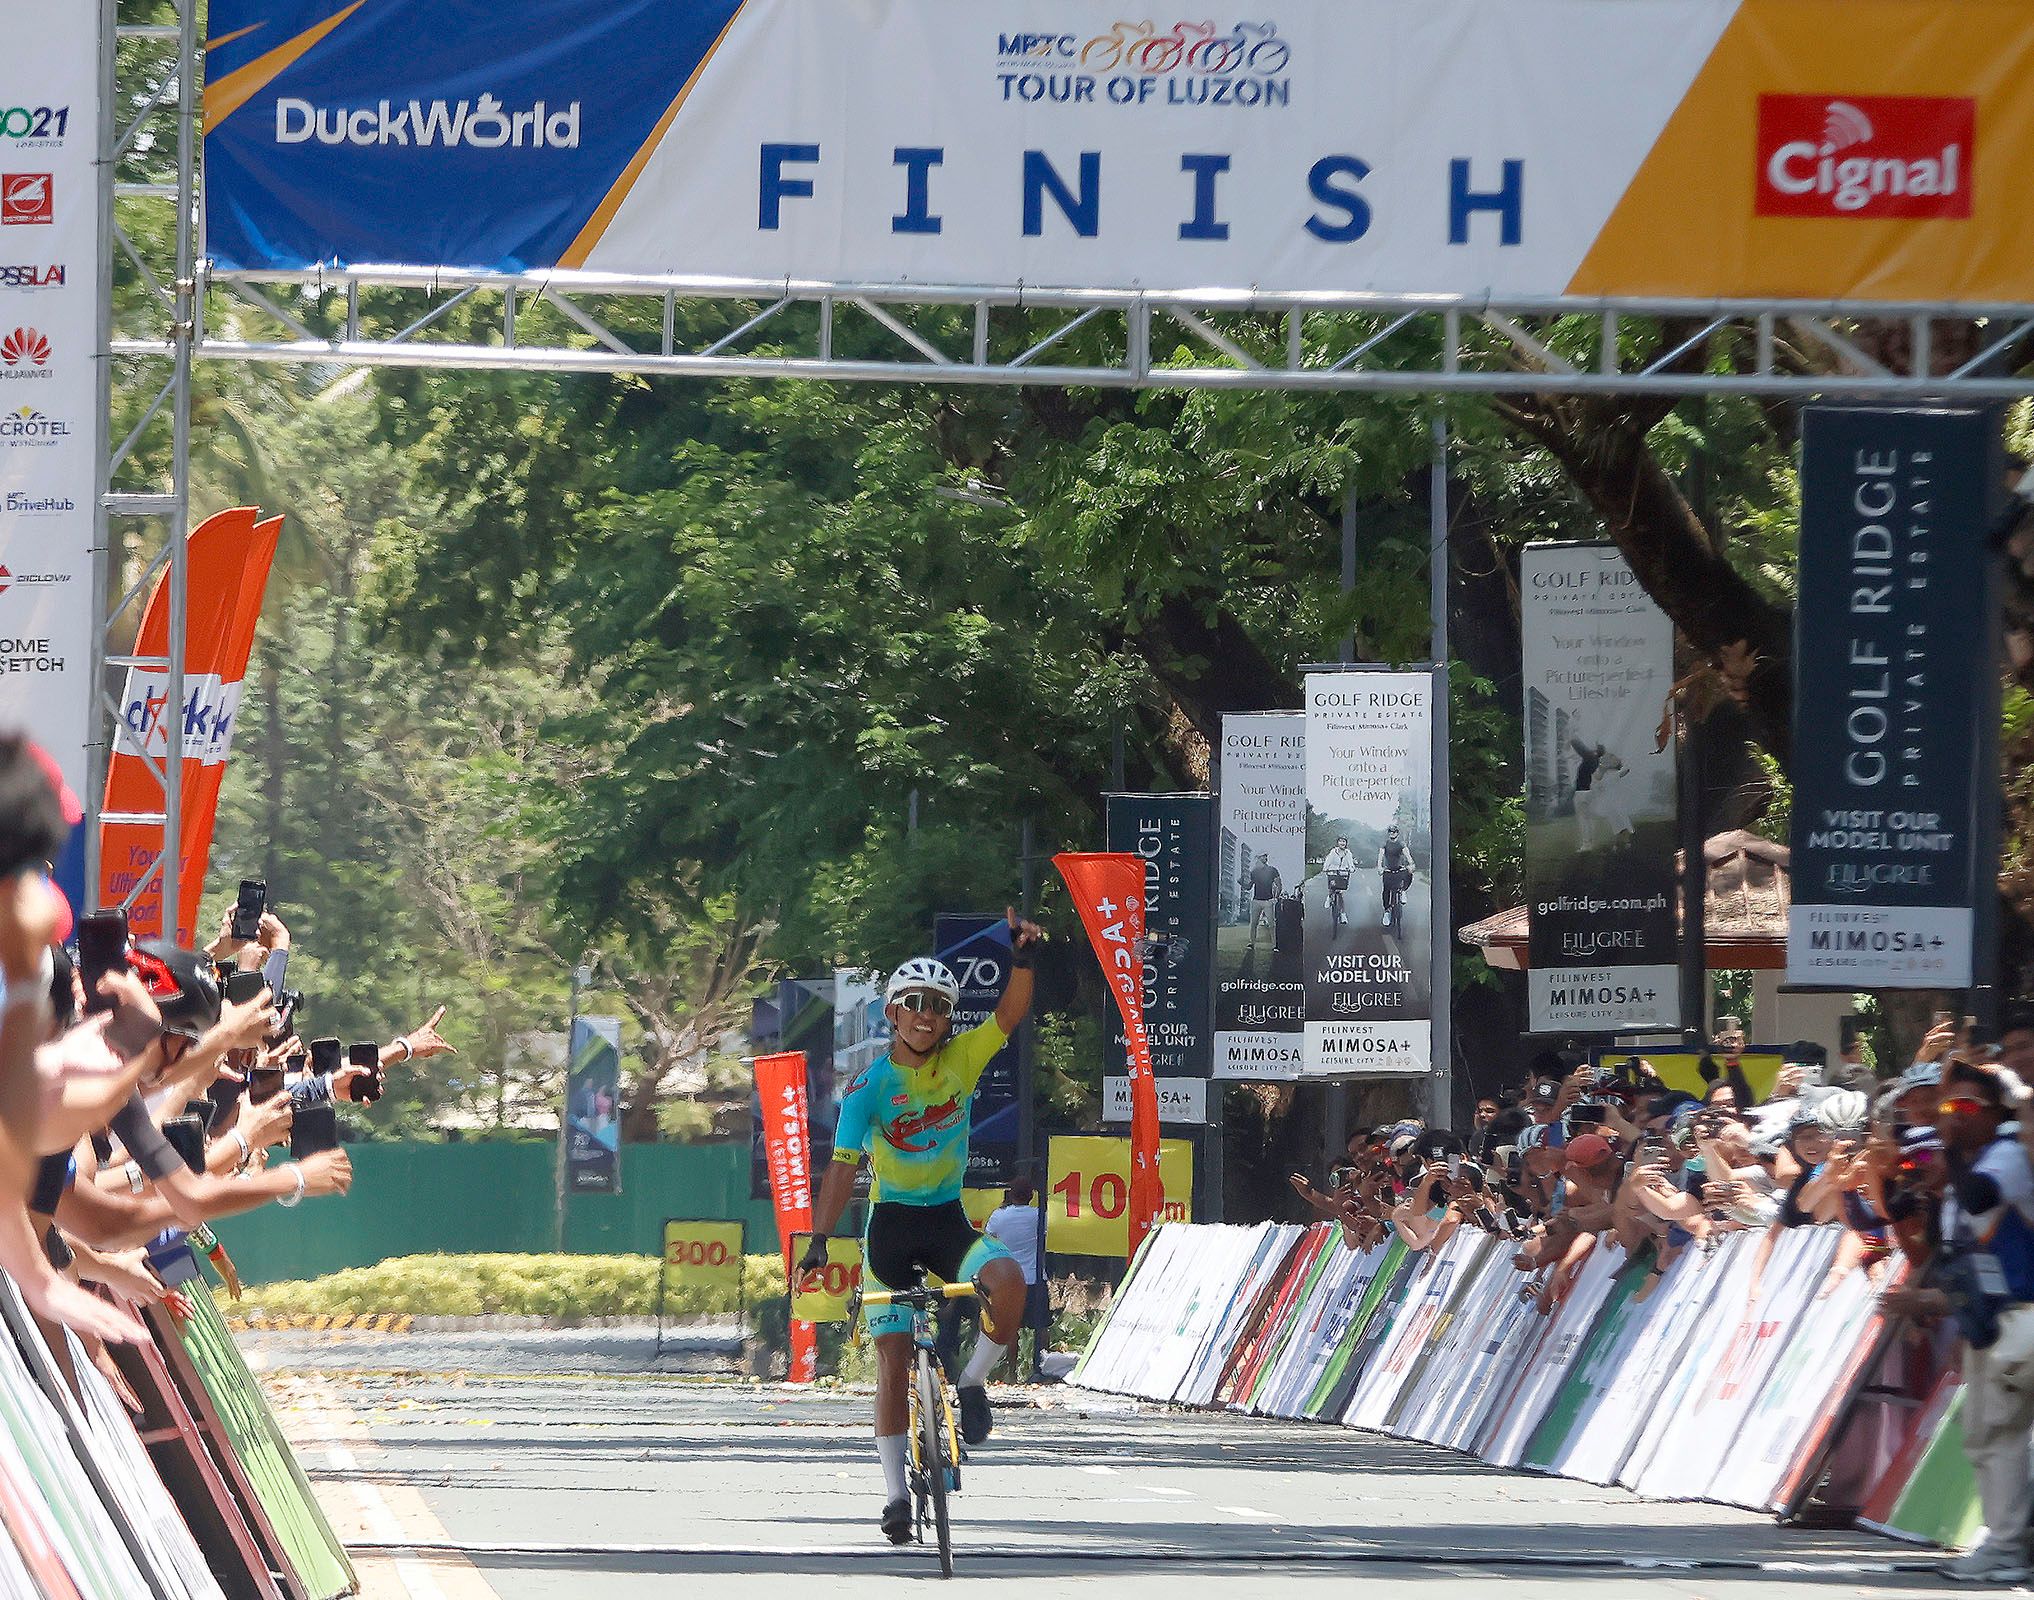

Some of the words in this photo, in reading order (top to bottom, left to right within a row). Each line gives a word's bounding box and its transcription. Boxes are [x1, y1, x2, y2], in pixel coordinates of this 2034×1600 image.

[998, 33, 1077, 56] MPTC
[997, 73, 1096, 103] TOUR
[1107, 75, 1157, 104] OF
[1167, 77, 1291, 106] LUZON
[276, 94, 580, 148] DuckWorld
[1767, 137, 1959, 211] Cignal
[758, 143, 1524, 246] FINISH
[7, 498, 75, 511] DriveHub
[1851, 448, 1898, 613] RIDGE
[1532, 570, 1591, 588] GOLF
[1600, 570, 1639, 587] RID
[1314, 693, 1362, 707] GOLF
[1369, 693, 1423, 707] RIDGE
[1903, 622, 1927, 787] PRIVATE
[1845, 638, 1890, 786] GOLF
[1227, 734, 1273, 748] GOLF
[1328, 746, 1355, 759] Your
[1360, 745, 1408, 758] Window
[1348, 762, 1377, 773] onto
[1379, 764, 1387, 773] a
[1240, 783, 1266, 795] Your
[1269, 783, 1306, 796] Windo
[1322, 775, 1412, 789] Picture-perfect
[1341, 789, 1393, 801] Getaway
[1259, 799, 1286, 809] onto
[1288, 800, 1296, 809] a
[1825, 810, 1884, 828] VISIT
[1888, 811, 1941, 830] OUR
[1808, 831, 1892, 850] MODEL
[1168, 818, 1182, 899] ESTATE
[1537, 893, 1668, 916] golfridge.com.ph
[1811, 930, 1945, 952] MIMOSA+
[1326, 955, 1366, 968] VISIT
[1368, 955, 1402, 968] OUR
[957, 957, 1000, 988] 70
[1317, 971, 1372, 983] MODEL
[1375, 970, 1412, 983] UNIT
[1550, 973, 1612, 983] FILINVEST
[1550, 986, 1656, 1006] MIMOSA+
[1159, 1023, 1189, 1035] OUR
[1322, 1026, 1374, 1034] FILINVEST
[1164, 1036, 1197, 1047] UNIT
[1322, 1038, 1411, 1053] MIMOSA+
